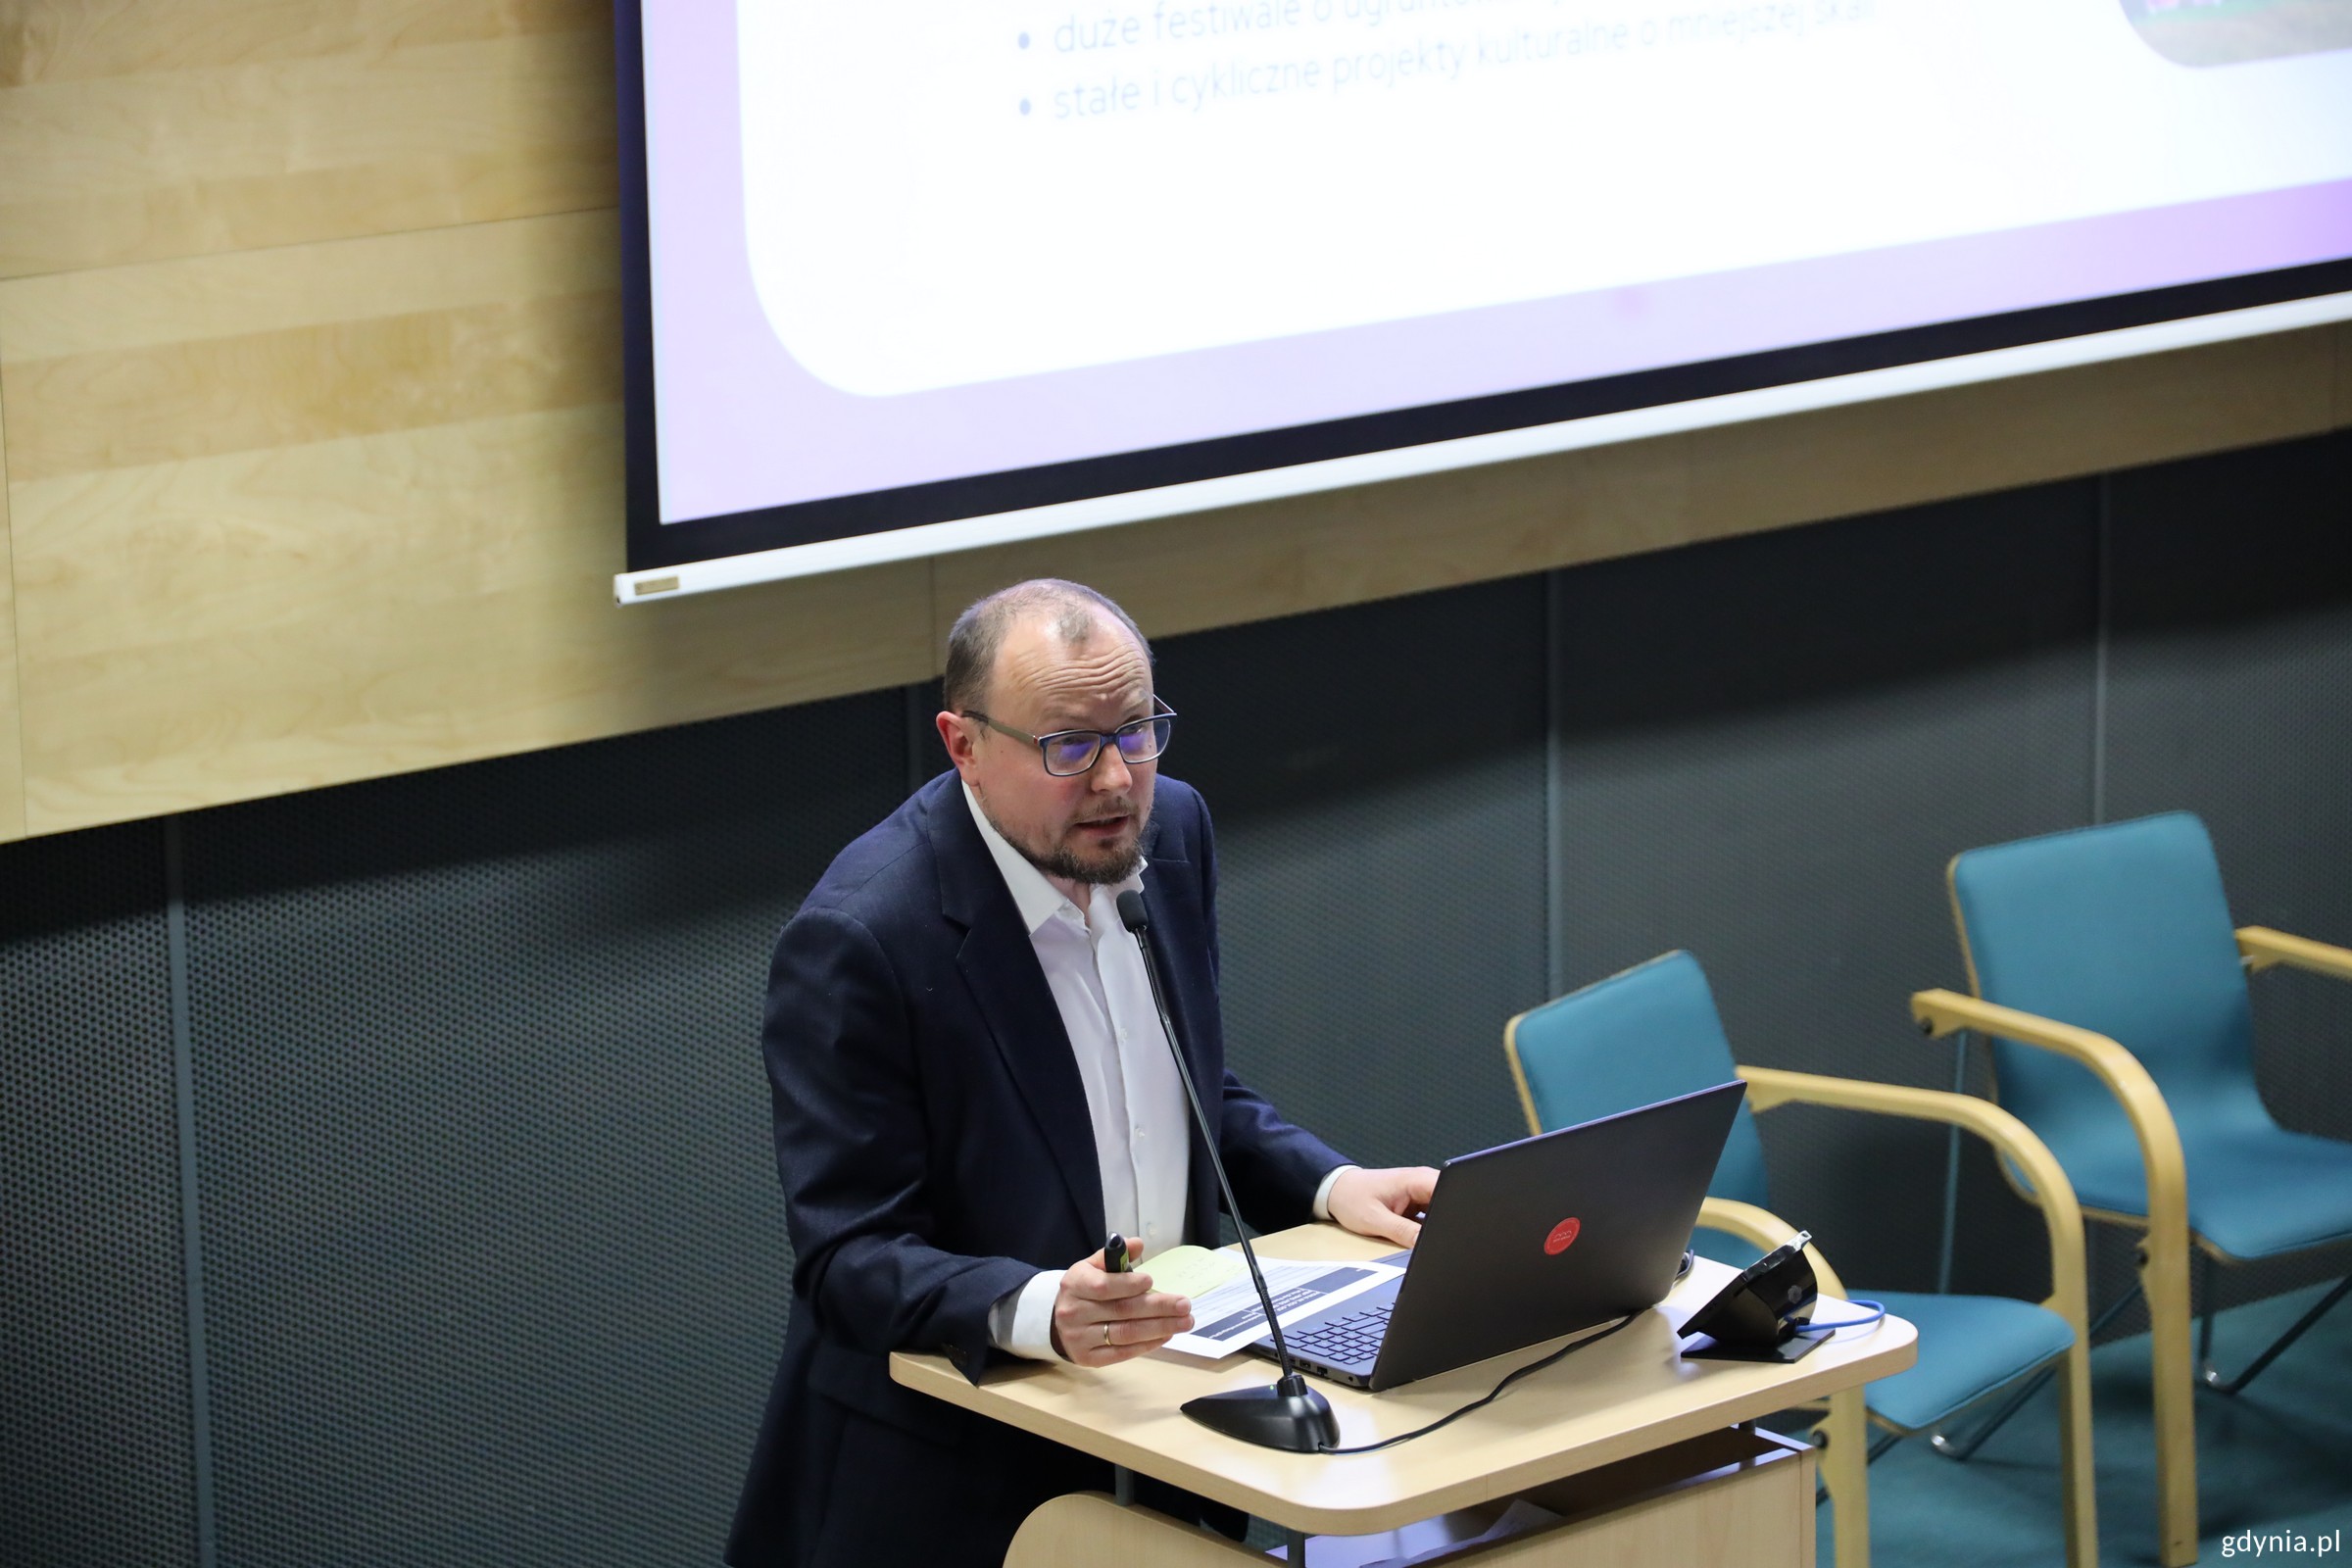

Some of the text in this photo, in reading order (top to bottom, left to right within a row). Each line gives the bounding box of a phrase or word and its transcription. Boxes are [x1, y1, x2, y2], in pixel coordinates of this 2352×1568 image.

[1053, 8, 1141, 53] duże
[1152, 0, 1302, 39] festiwale
[1053, 74, 1142, 120] stałe
[1152, 66, 1161, 107] i
[1171, 56, 1321, 114] cykliczne
[1333, 36, 1469, 94] projekty
[1476, 17, 1629, 63] kulturalne
[1640, 19, 1658, 47] o
[1668, 1, 1805, 47] mniejszej
